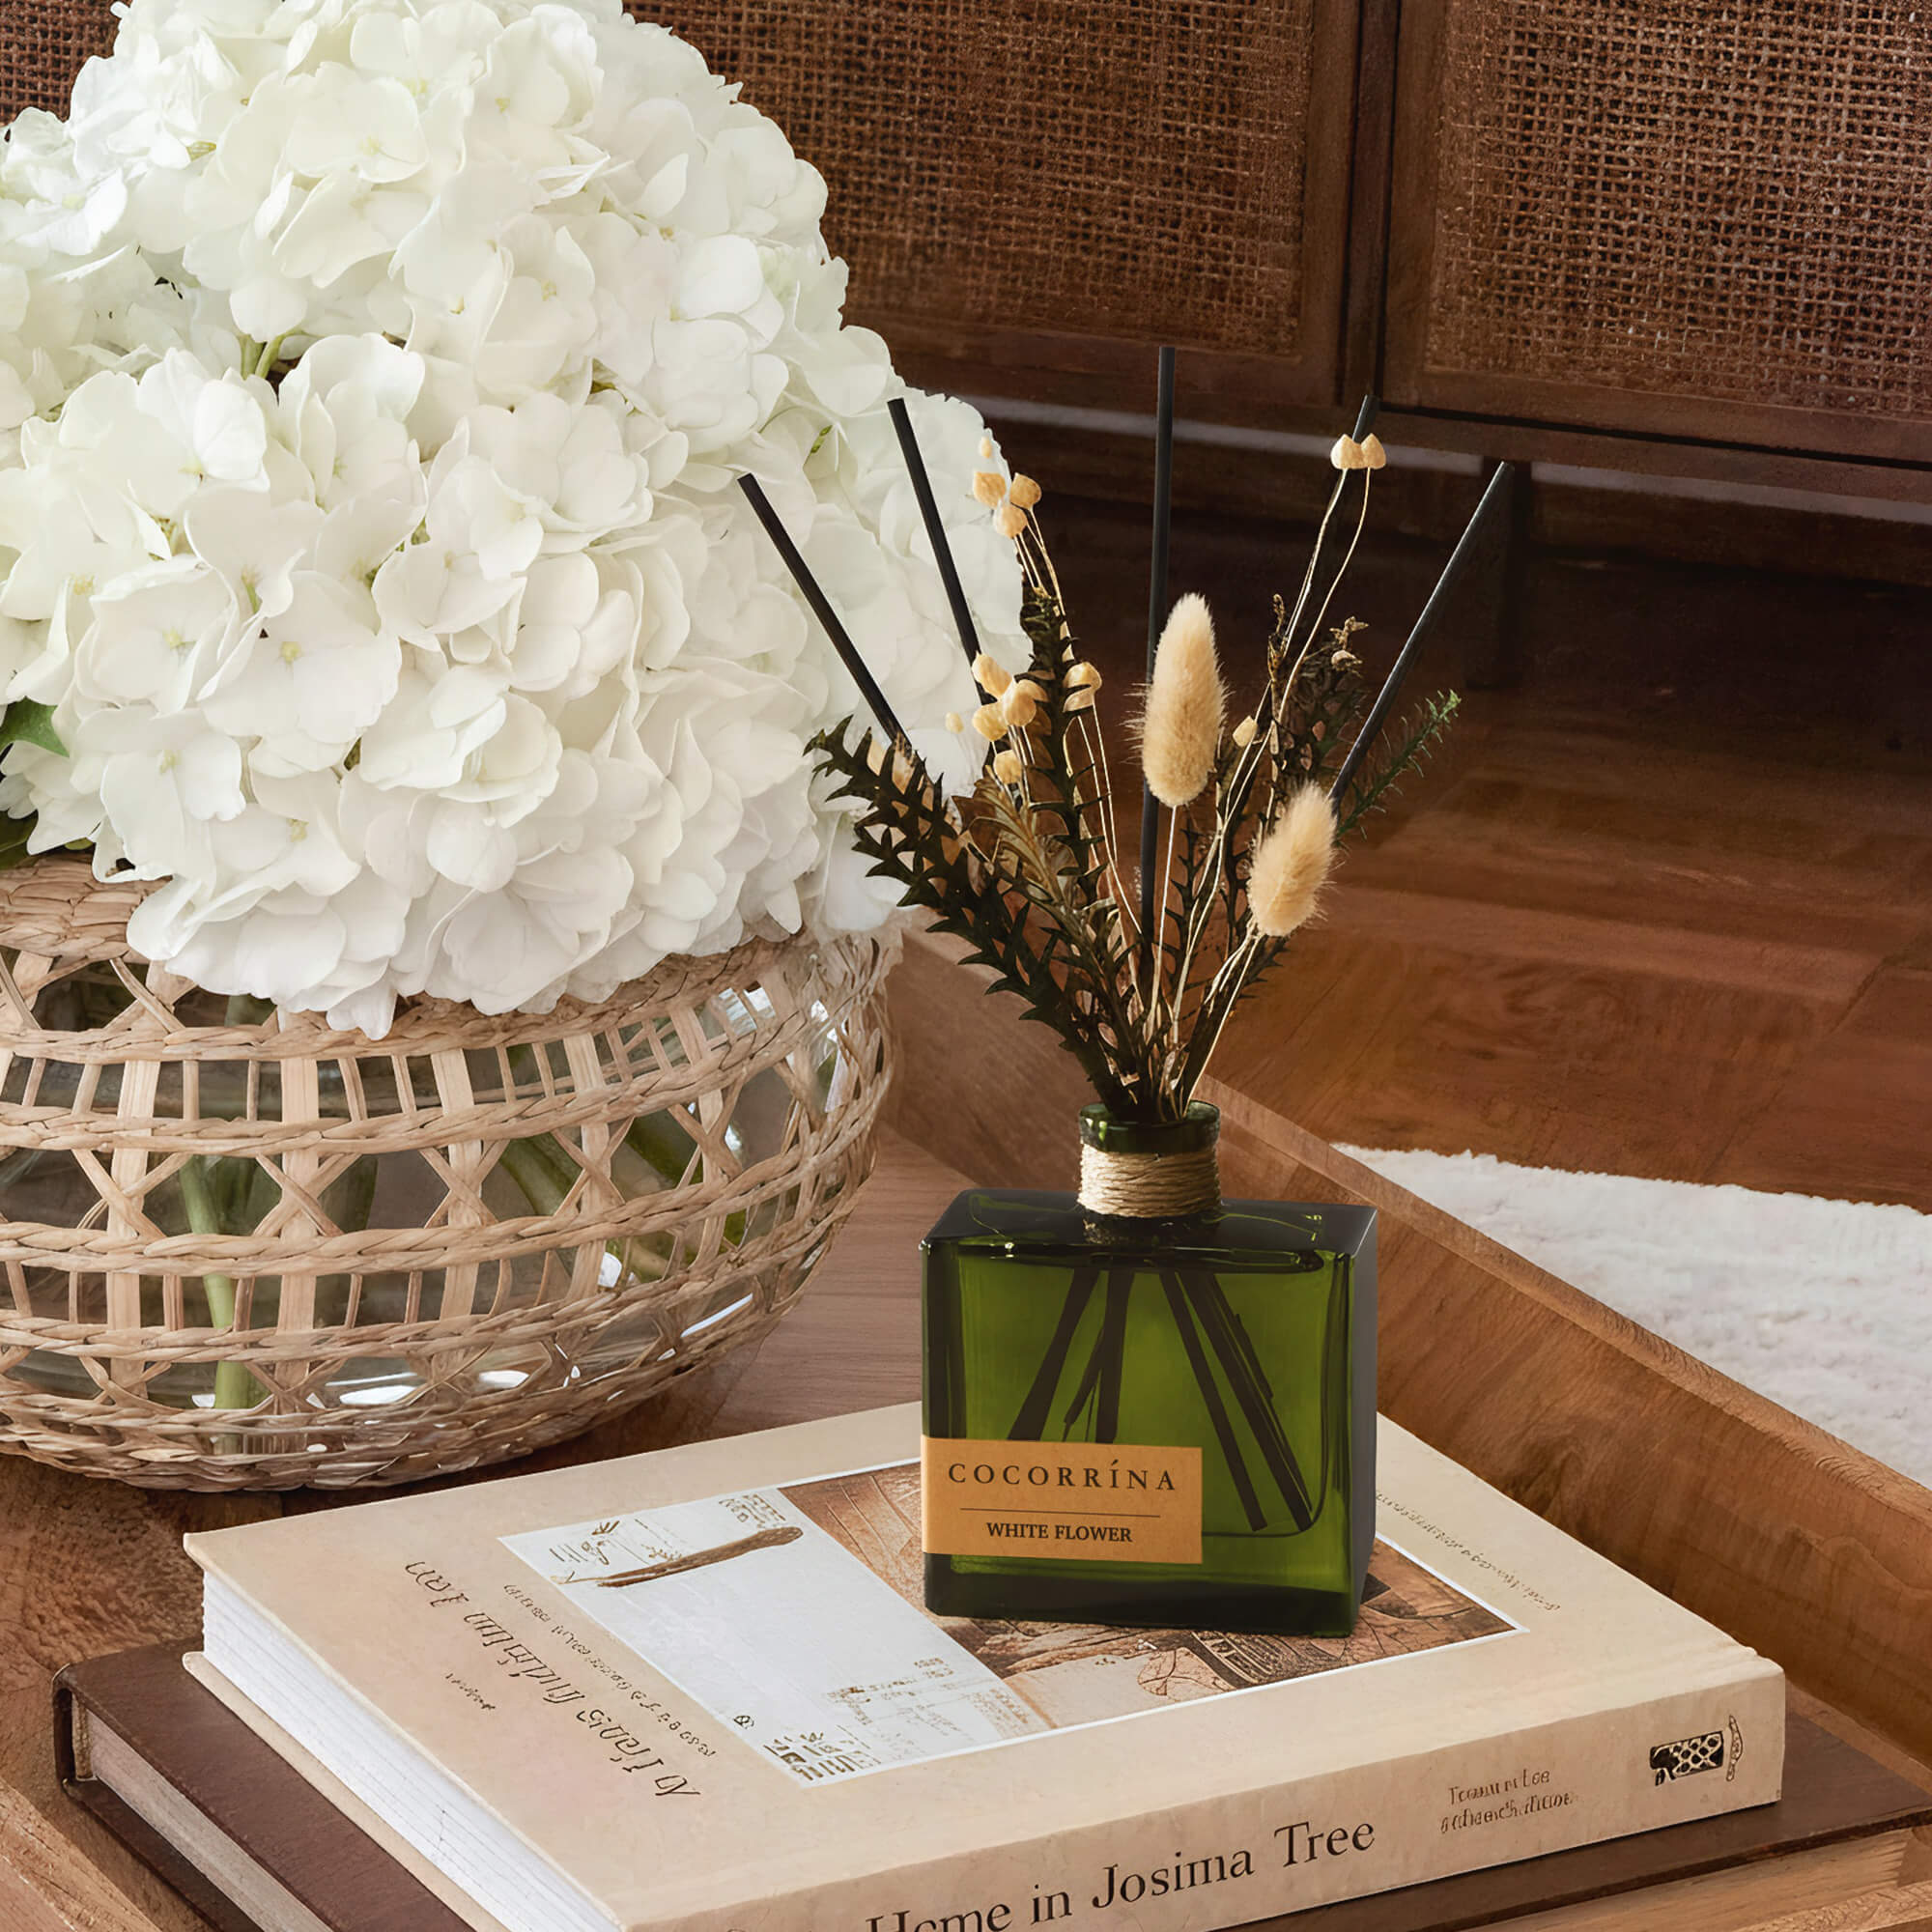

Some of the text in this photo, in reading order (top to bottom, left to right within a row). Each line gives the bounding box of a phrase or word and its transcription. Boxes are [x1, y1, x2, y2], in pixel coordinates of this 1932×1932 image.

[948, 1459, 1176, 1491] COCORRÍNA
[986, 1521, 1134, 1543] WHITE FLOWER
[1030, 1884, 1073, 1926] in
[1273, 1820, 1376, 1868] Tree
